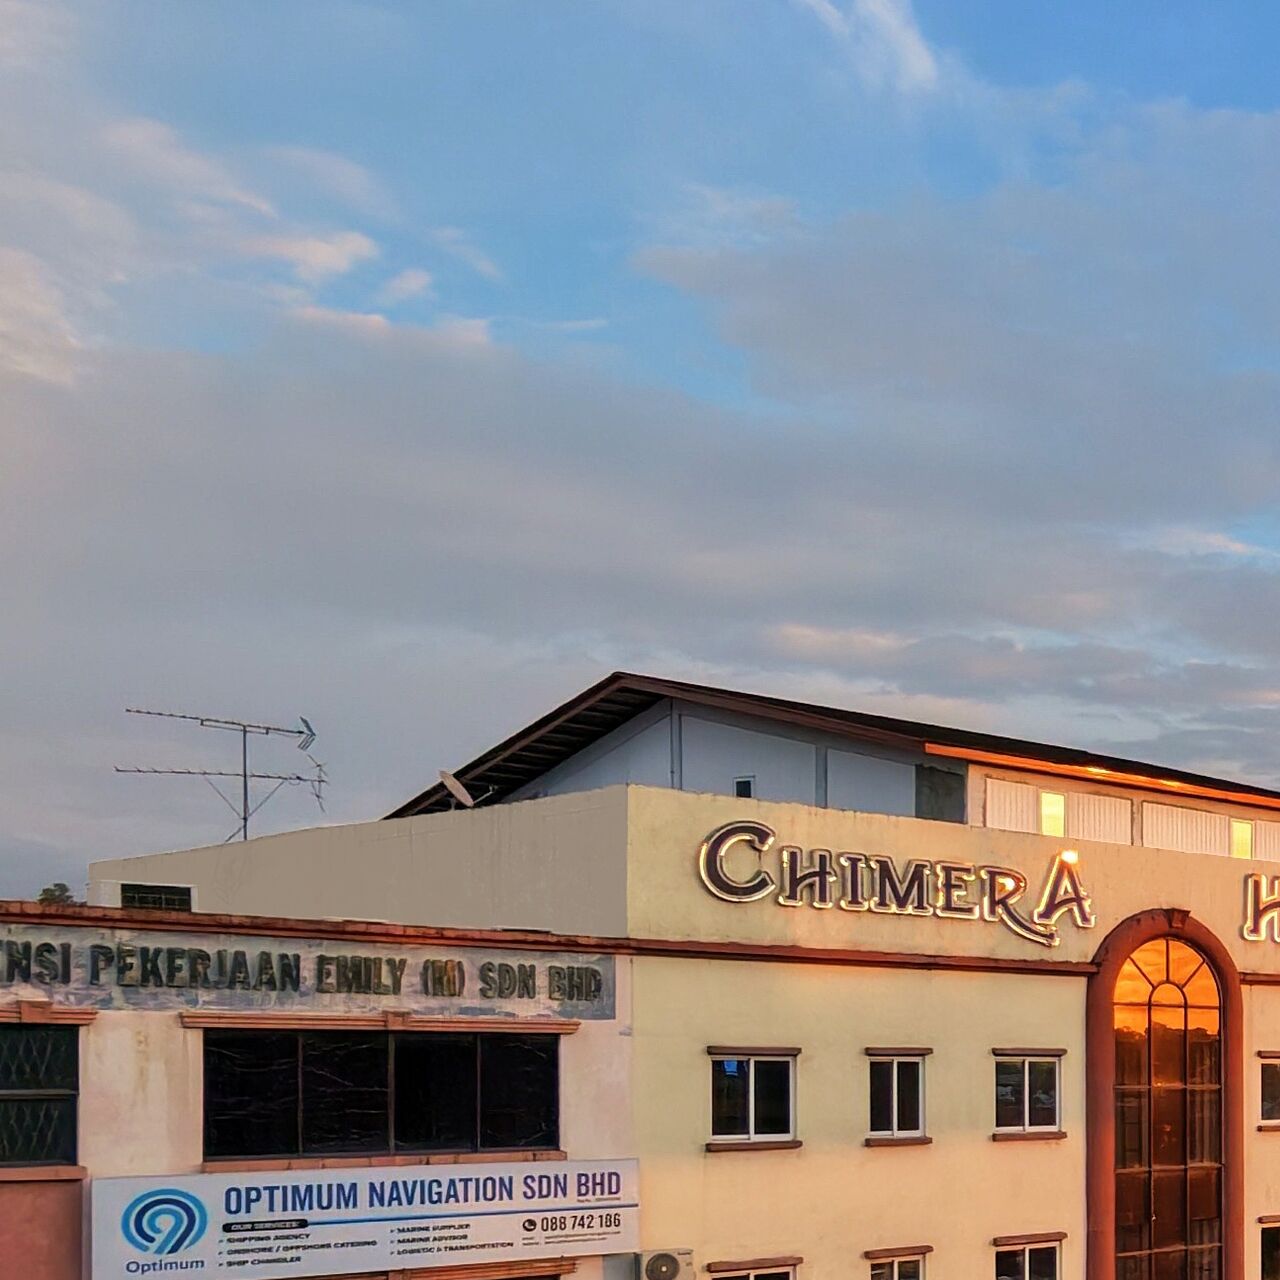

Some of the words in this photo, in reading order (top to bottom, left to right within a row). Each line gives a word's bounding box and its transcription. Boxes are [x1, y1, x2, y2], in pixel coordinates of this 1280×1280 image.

[697, 818, 1097, 947] CHIMERA
[0, 939, 71, 984] NSI
[89, 944, 301, 992] PEKERJAAN
[316, 955, 407, 995] EMILY
[479, 962, 537, 999] SDN
[548, 964, 603, 1001] BHD
[224, 1182, 358, 1215] OPTIMUM
[368, 1175, 514, 1208] NAVIGATION
[523, 1173, 568, 1200] SDN
[577, 1171, 621, 1197] BHD
[541, 1216, 567, 1232] 088
[571, 1214, 594, 1230] 742
[126, 1259, 205, 1275] Optimum
